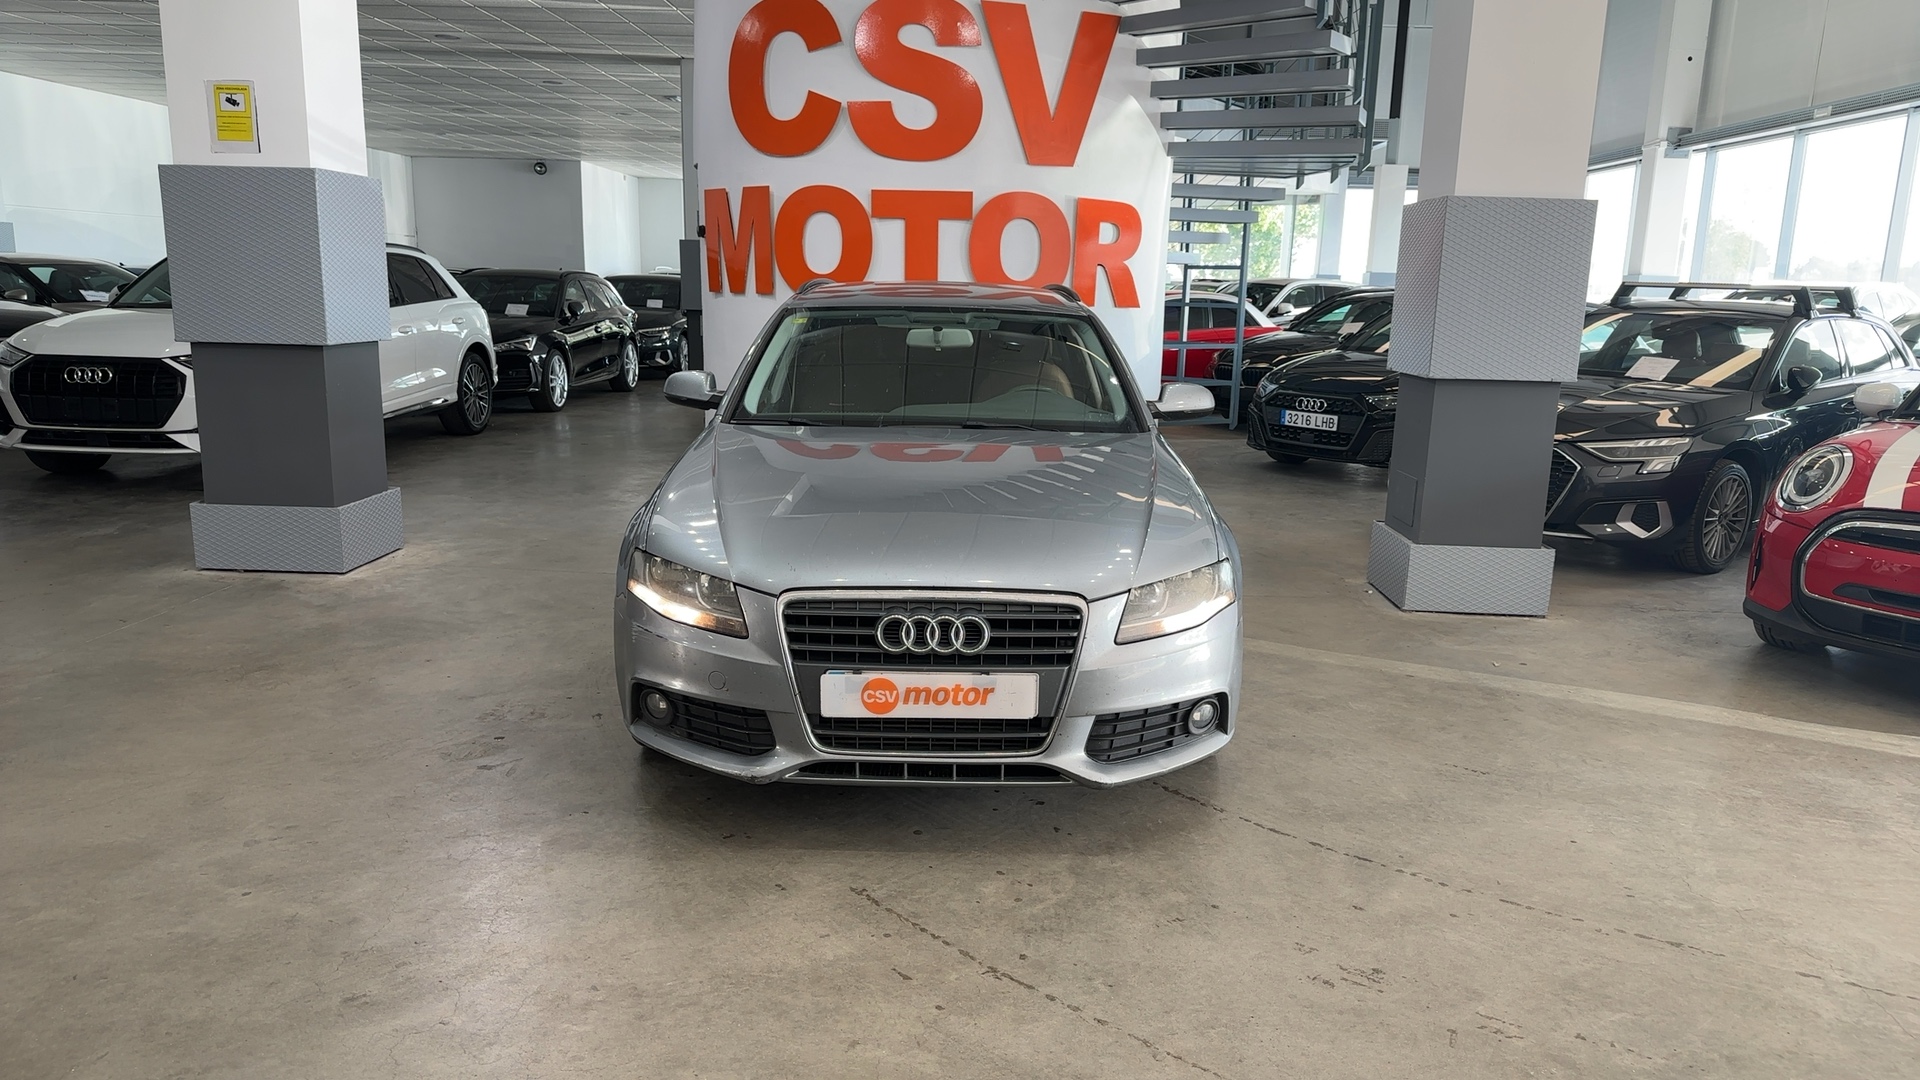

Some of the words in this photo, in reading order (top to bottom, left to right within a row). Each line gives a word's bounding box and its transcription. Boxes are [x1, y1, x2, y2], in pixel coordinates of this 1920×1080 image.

[728, 0, 1122, 167] CSV
[704, 185, 1142, 309] MOTOR
[1287, 413, 1311, 426] 3216
[1315, 416, 1335, 429] LHB
[902, 683, 995, 706] motor
